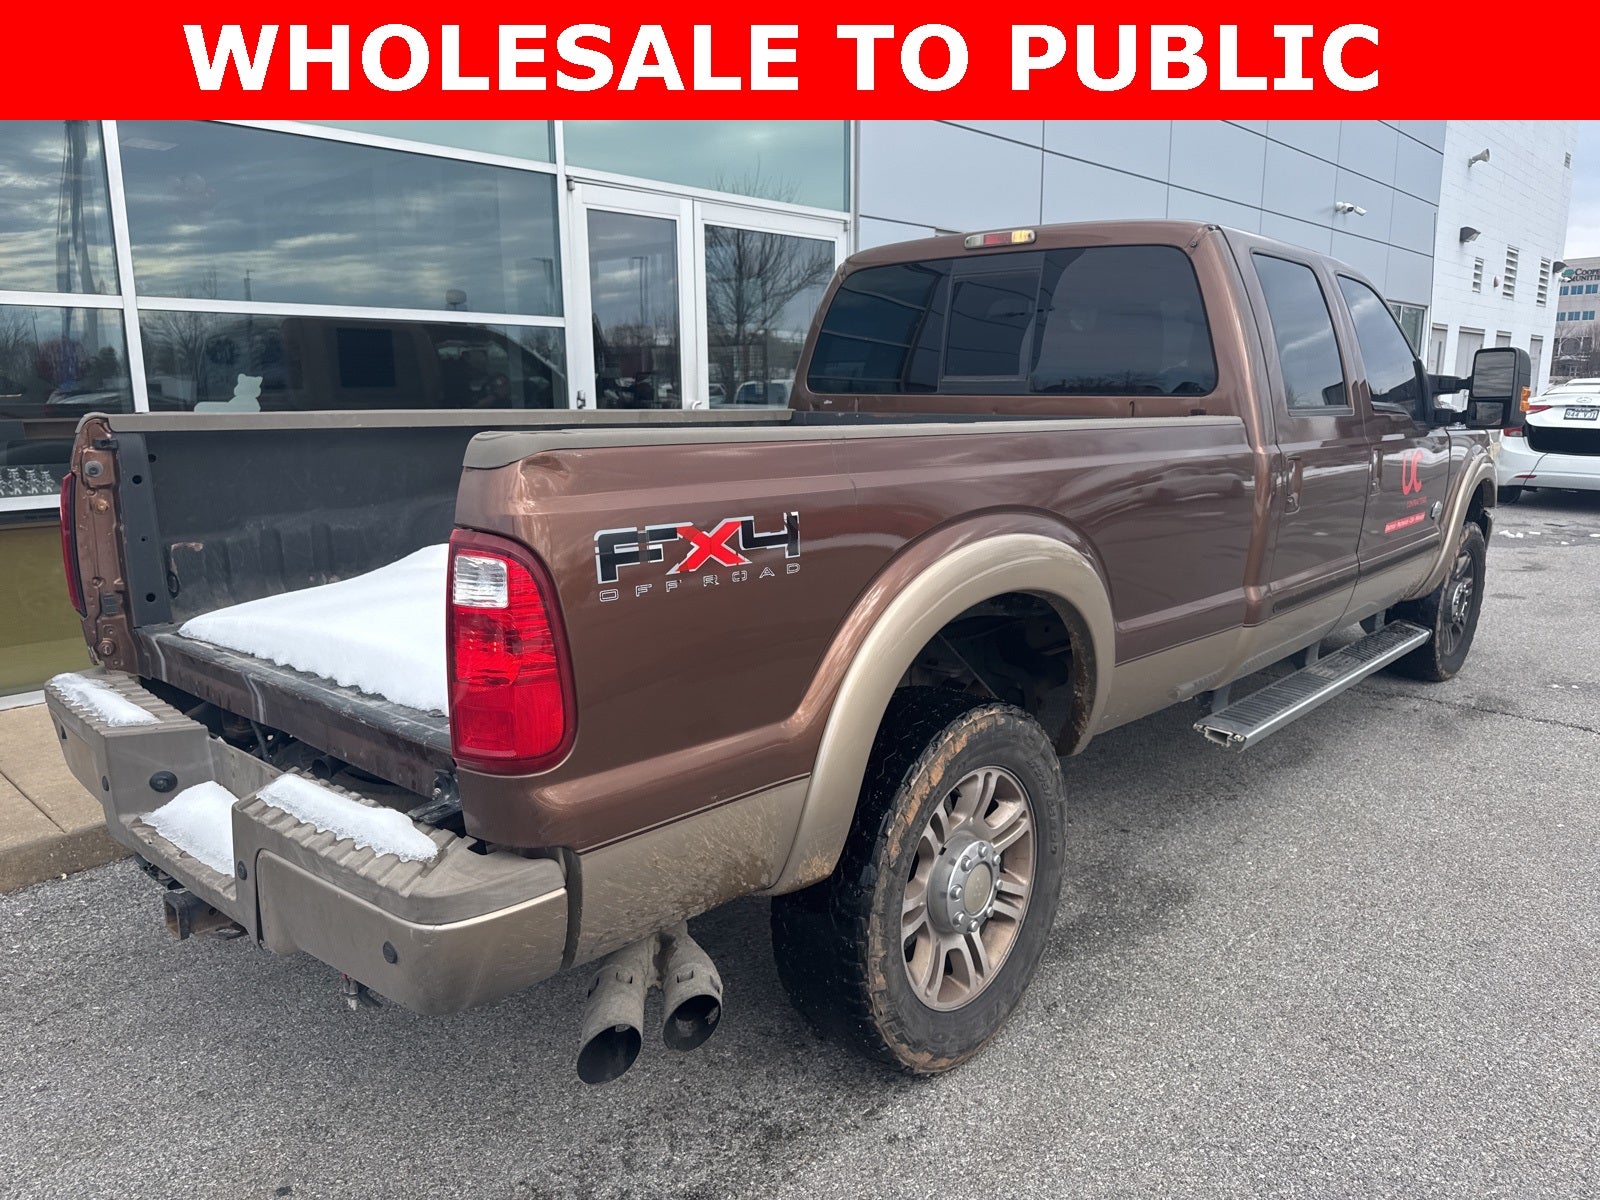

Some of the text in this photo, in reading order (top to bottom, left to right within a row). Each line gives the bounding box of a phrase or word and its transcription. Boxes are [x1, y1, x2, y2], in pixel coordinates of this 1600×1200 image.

[594, 511, 800, 584] FX4
[599, 563, 800, 602] OFF ROAD
